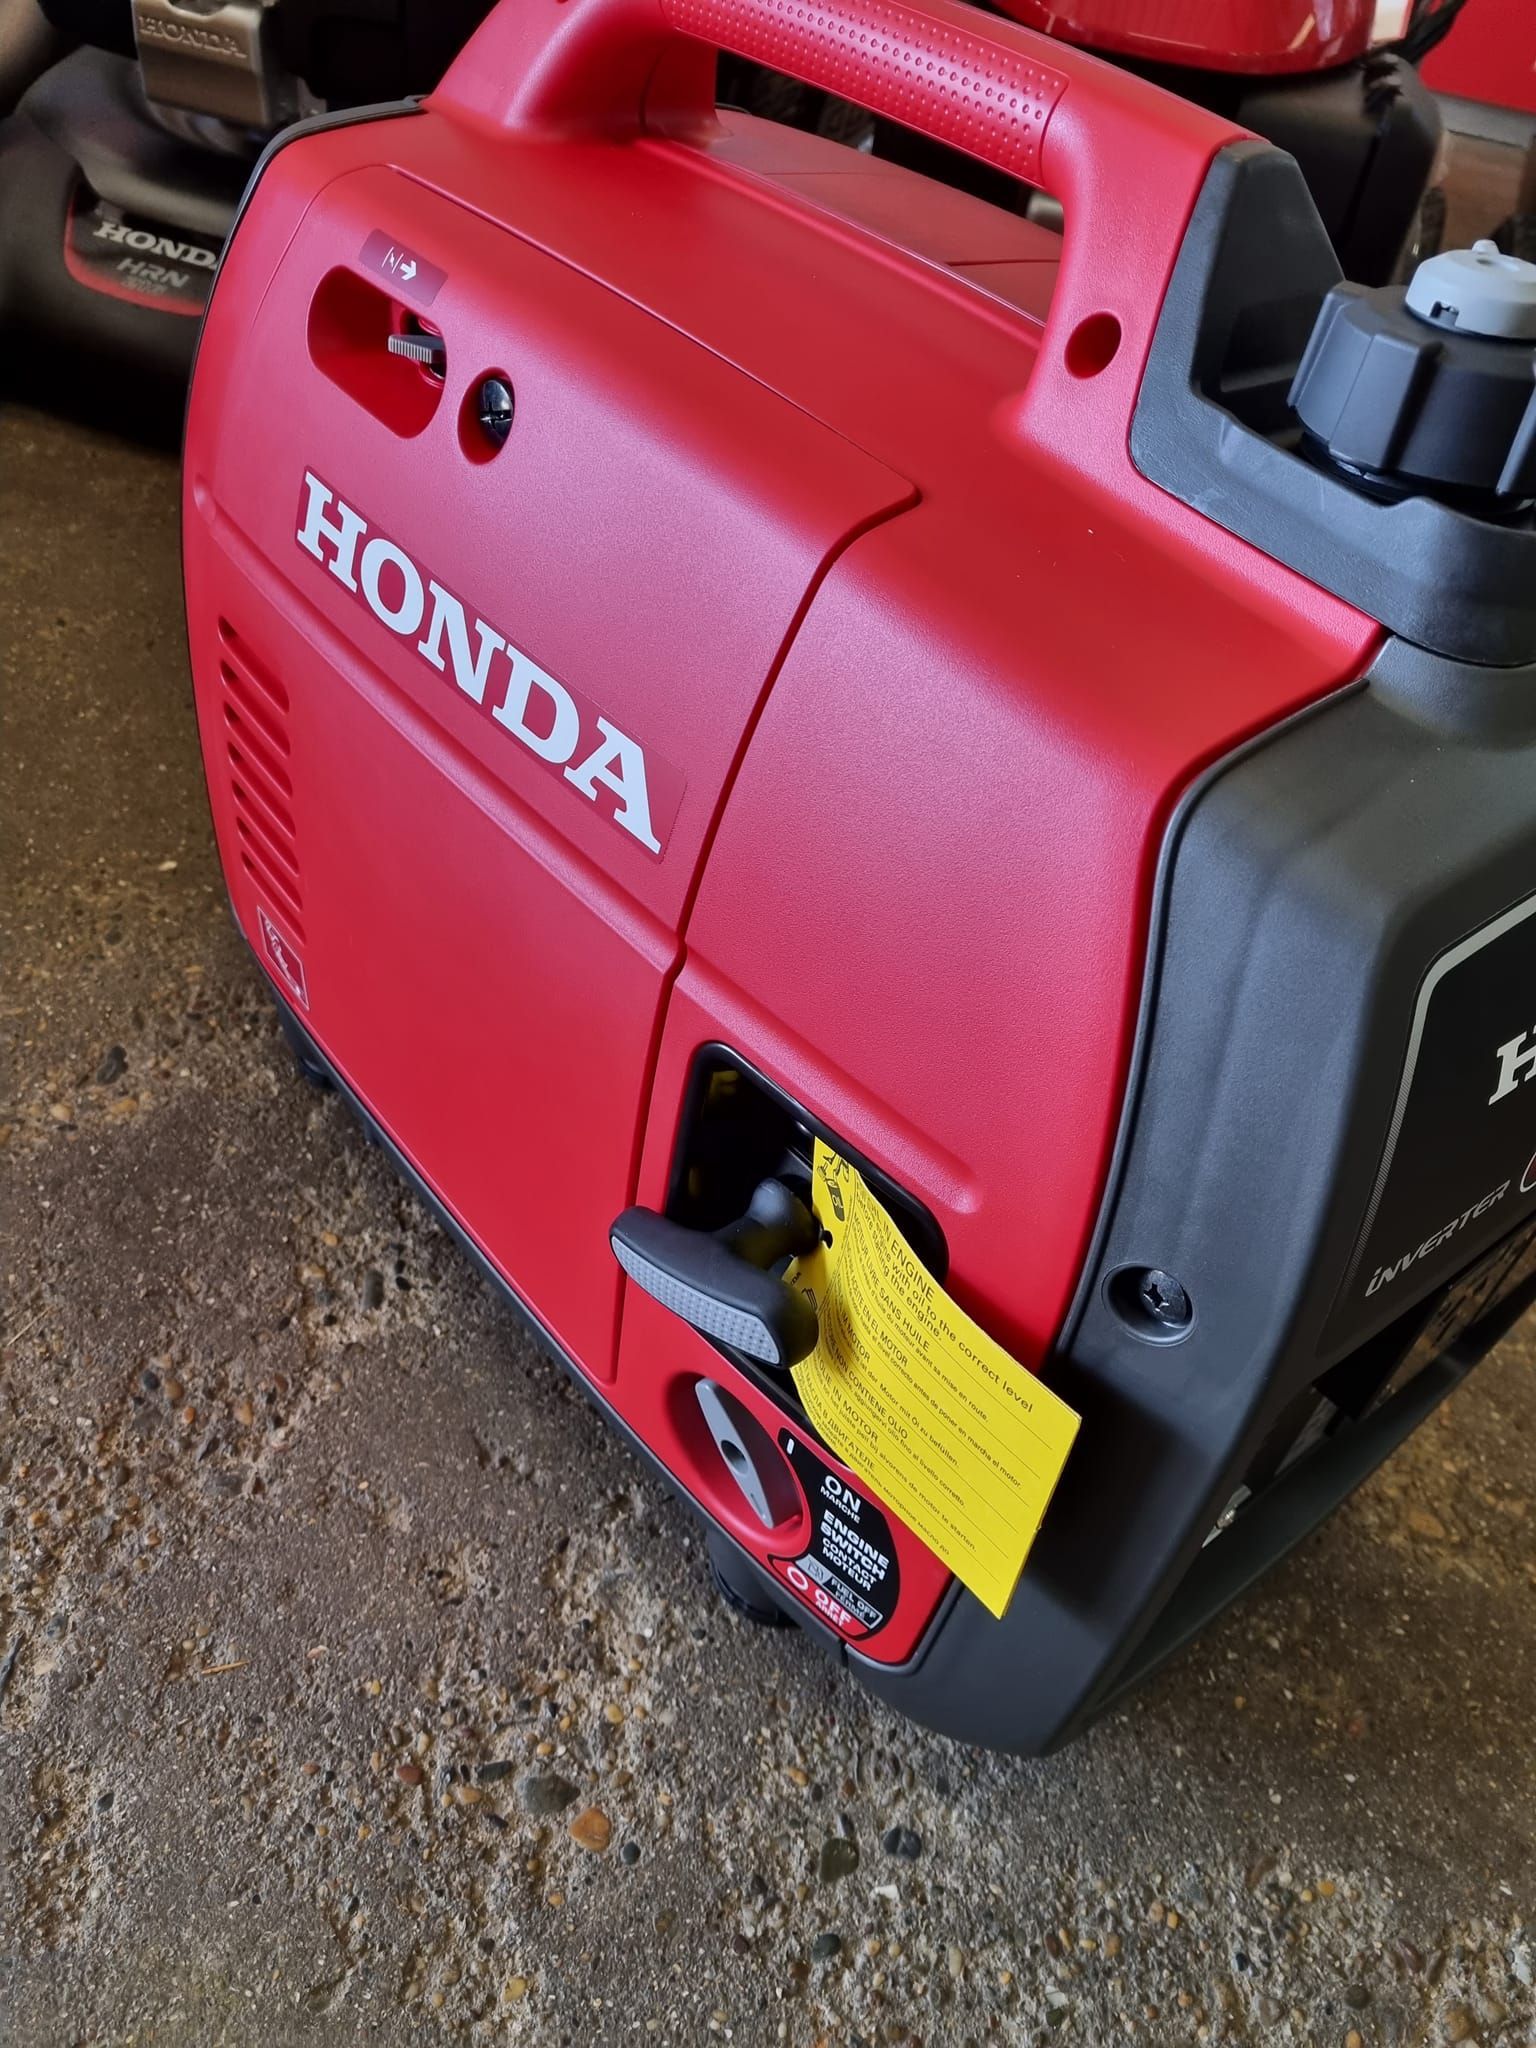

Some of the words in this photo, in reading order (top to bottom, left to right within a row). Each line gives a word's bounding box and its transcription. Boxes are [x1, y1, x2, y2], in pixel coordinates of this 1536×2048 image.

[138, 16, 248, 59] HONDA
[93, 221, 219, 270] HOND
[116, 257, 190, 289] HRN
[297, 471, 661, 854] HONDA
[890, 1239, 935, 1304] ENGINE
[879, 1287, 902, 1321] SANS
[902, 1317, 930, 1353] HUILE
[891, 1274, 906, 1297] the
[906, 1296, 942, 1341] engine.
[847, 1323, 871, 1364] MOTOR
[862, 1304, 873, 1322] EN
[870, 1319, 880, 1336] EL
[879, 1330, 909, 1367] MOTOR
[892, 1261, 911, 1290] with
[912, 1289, 926, 1308] oil
[926, 1305, 937, 1321] to
[938, 1319, 957, 1342] the
[958, 1341, 1001, 1385] correct
[1002, 1380, 1034, 1413] level
[894, 1324, 915, 1348] moteur
[915, 1346, 934, 1368] avant
[933, 1365, 941, 1377] sa
[940, 1375, 958, 1393] mise
[958, 1391, 968, 1403] en
[968, 1400, 989, 1422] route.
[832, 1385, 843, 1403] IN
[842, 1399, 879, 1443] MOTOR
[848, 1370, 887, 1418] CONTIENE
[887, 1415, 909, 1440] OLIO
[879, 1383, 898, 1405] Motor
[899, 1405, 911, 1419] mit
[920, 1426, 928, 1437] zu
[890, 1358, 913, 1384] correcto
[913, 1382, 930, 1401] antes
[930, 1399, 939, 1410] de
[939, 1408, 958, 1427] poner
[958, 1426, 967, 1438] en
[967, 1436, 992, 1461] marcha
[992, 1459, 1000, 1468] el
[828, 1418, 876, 1470] ДВИГАТЕЛЕ
[820, 1486, 861, 1525] MARCHE
[824, 1475, 862, 1513] ON
[908, 1480, 918, 1493] de
[918, 1492, 941, 1515] motor
[820, 1521, 886, 1582] SWITCH
[822, 1537, 878, 1585] CONTACT
[823, 1509, 890, 1570] ENGINE
[822, 1547, 872, 1592] MOTEUR
[815, 1589, 852, 1625] OFF
[831, 1578, 854, 1603] FUEL
[857, 1600, 877, 1619] OFF
